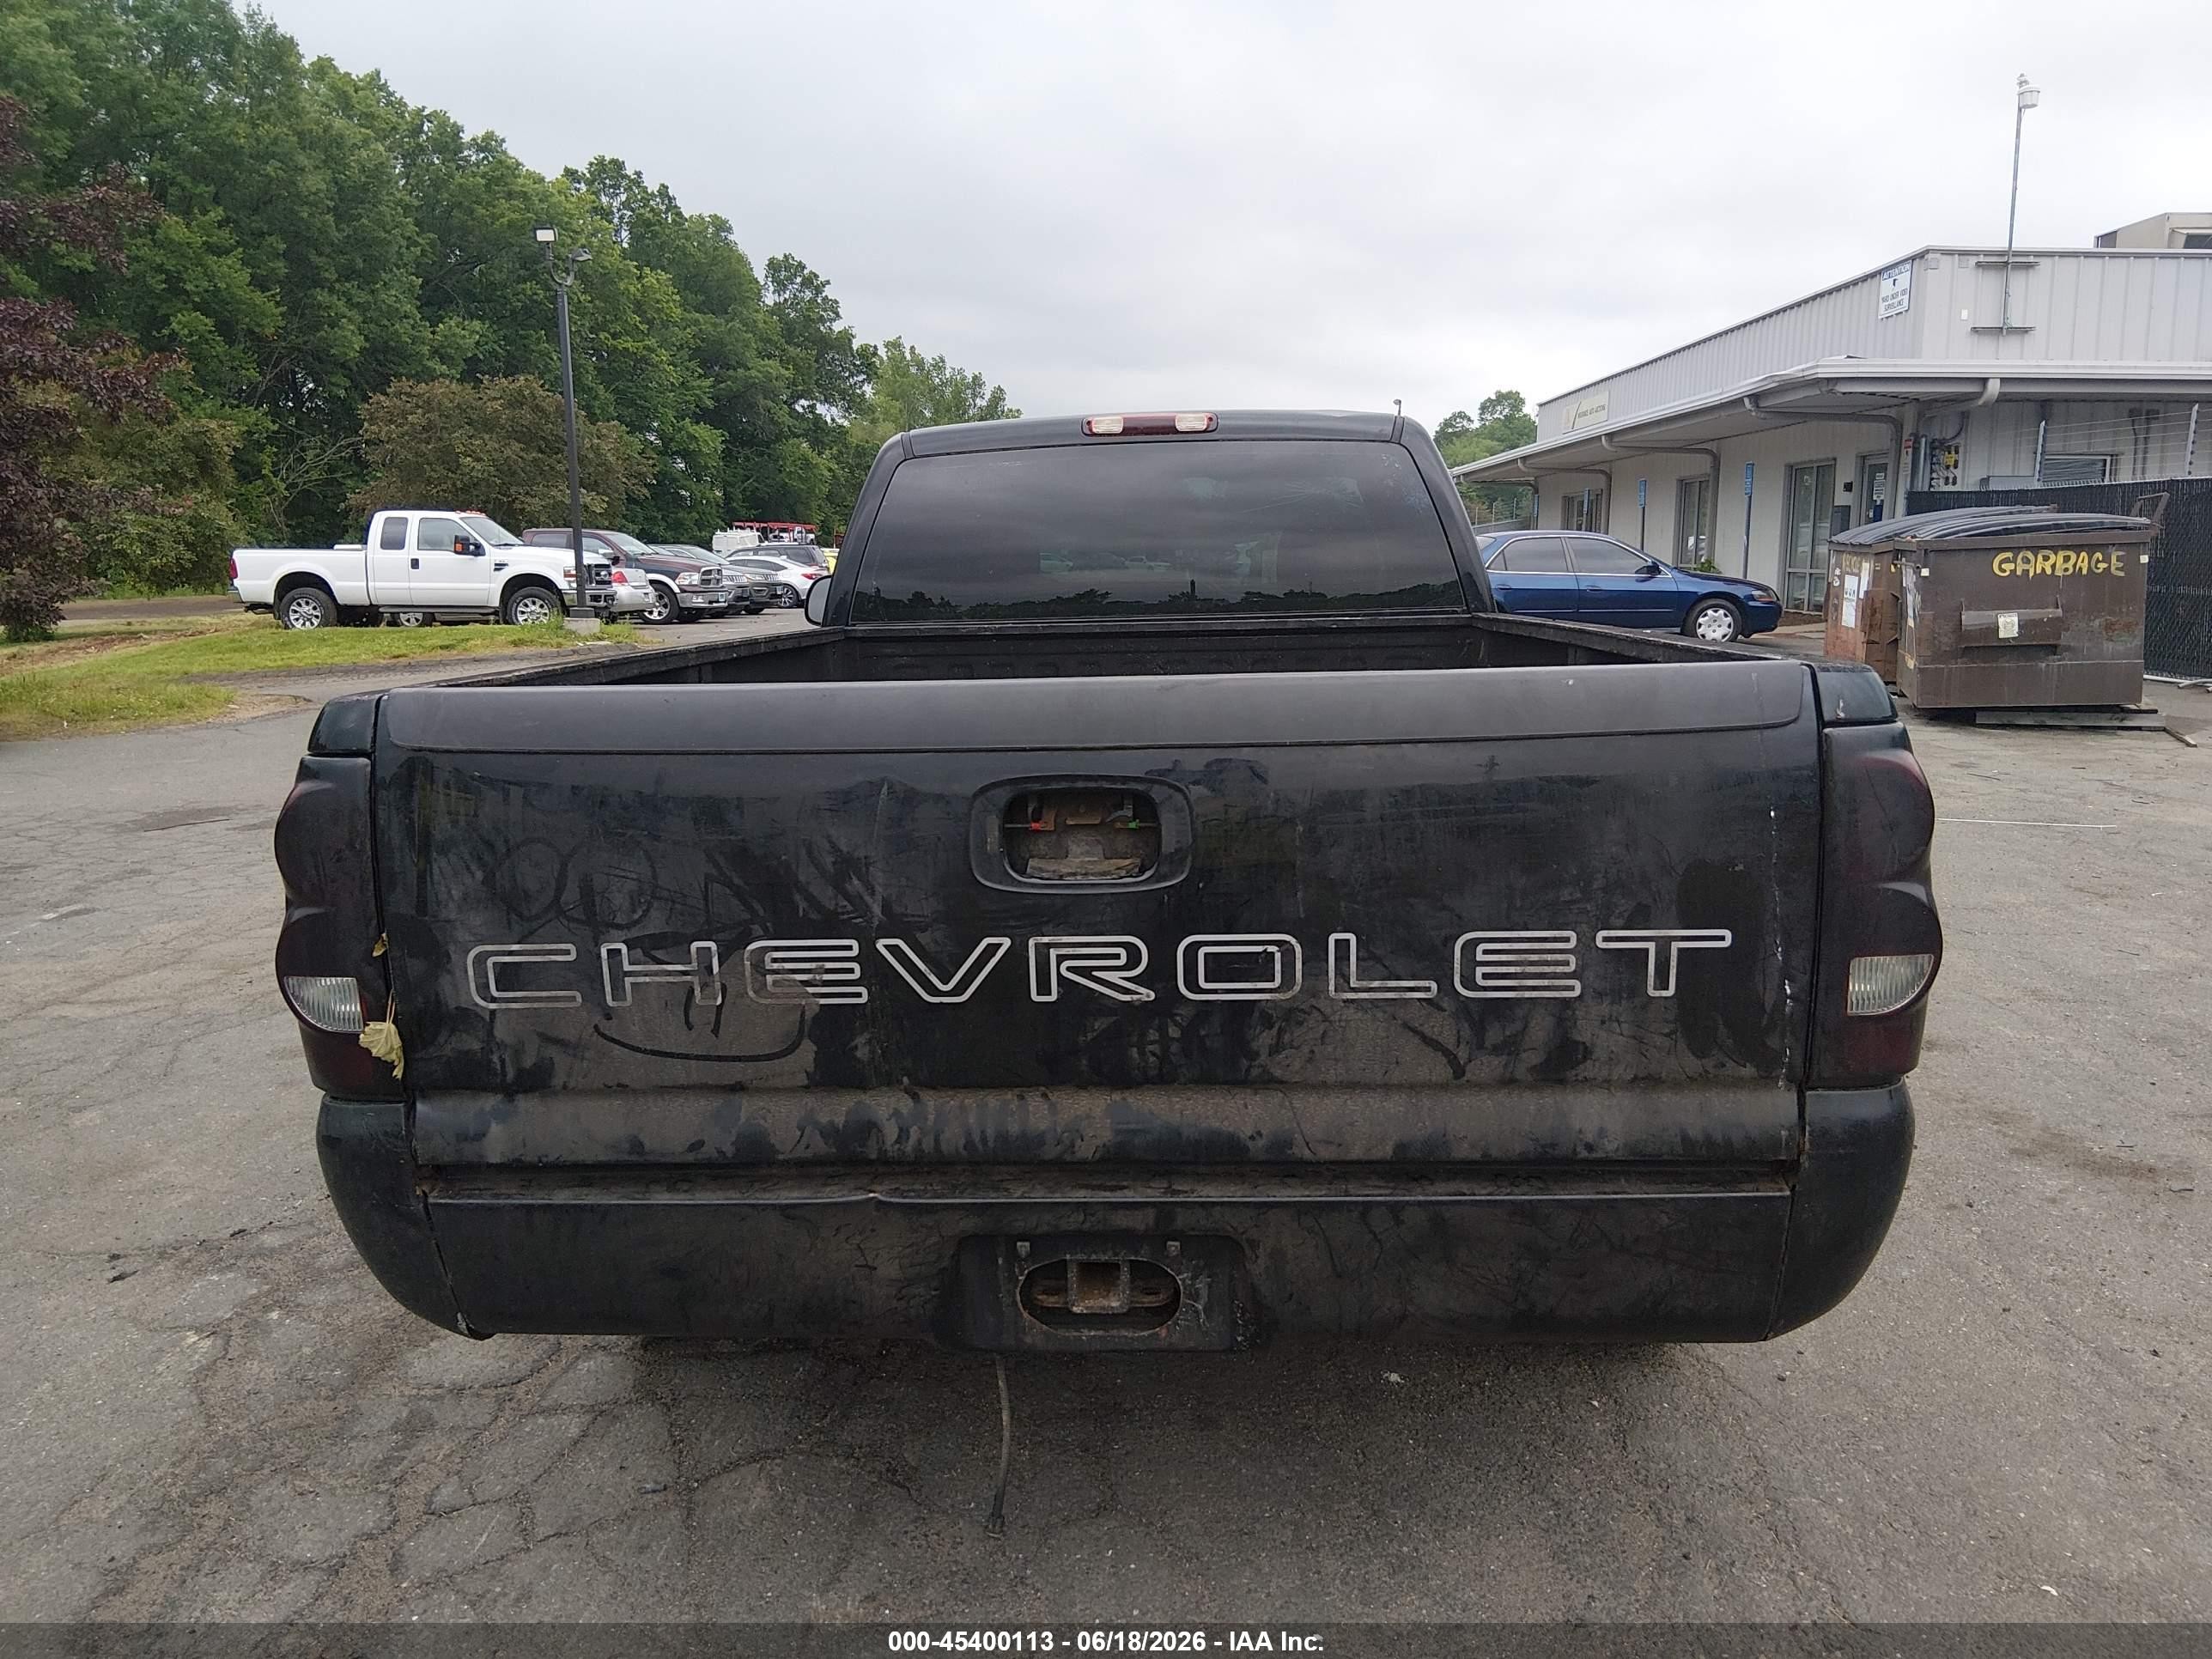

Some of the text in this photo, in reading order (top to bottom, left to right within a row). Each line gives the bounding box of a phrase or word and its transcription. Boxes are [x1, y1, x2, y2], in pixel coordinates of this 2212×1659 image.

[1882, 264, 1910, 279] ATTENTION
[1992, 549, 2126, 577] GARBAGE
[465, 927, 1733, 1011] CHEVROLET
